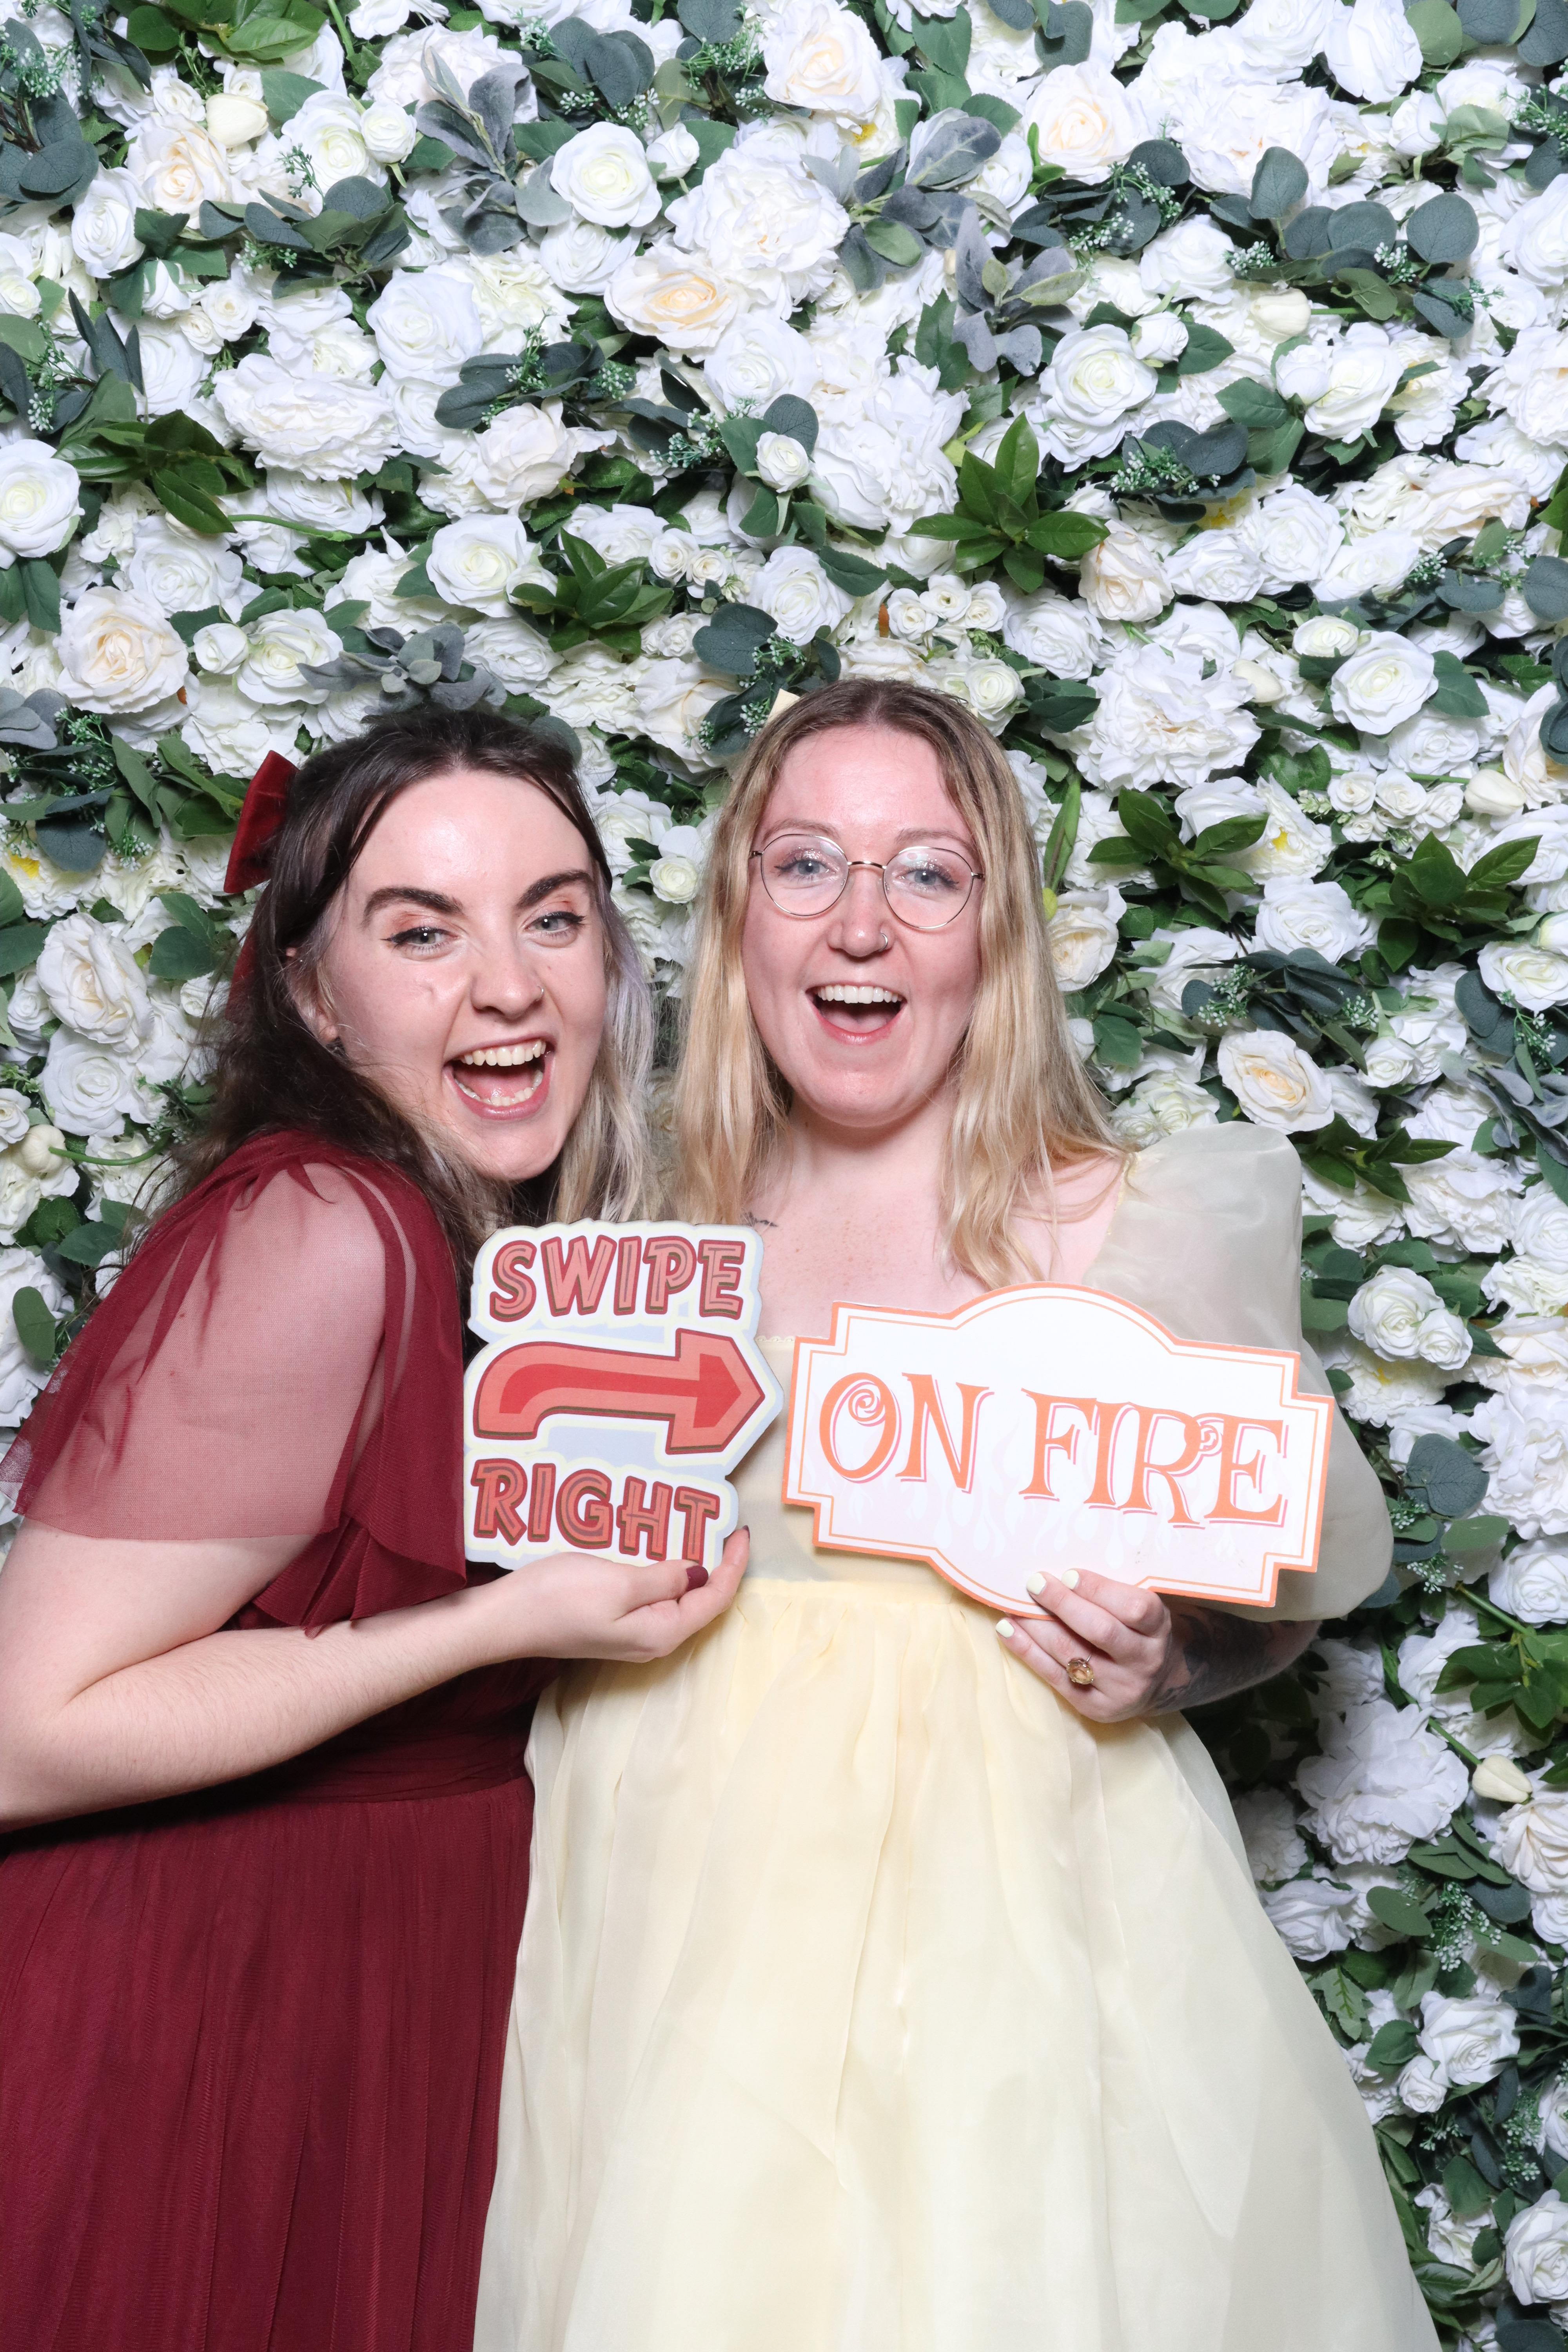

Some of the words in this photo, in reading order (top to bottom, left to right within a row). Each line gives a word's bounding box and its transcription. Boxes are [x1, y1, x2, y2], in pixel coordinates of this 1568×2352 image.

[490, 1234, 746, 1322] SWIPE
[819, 1372, 995, 1493] ON
[1018, 1388, 1289, 1530] FIRE
[471, 1458, 720, 1565] RIGHT
